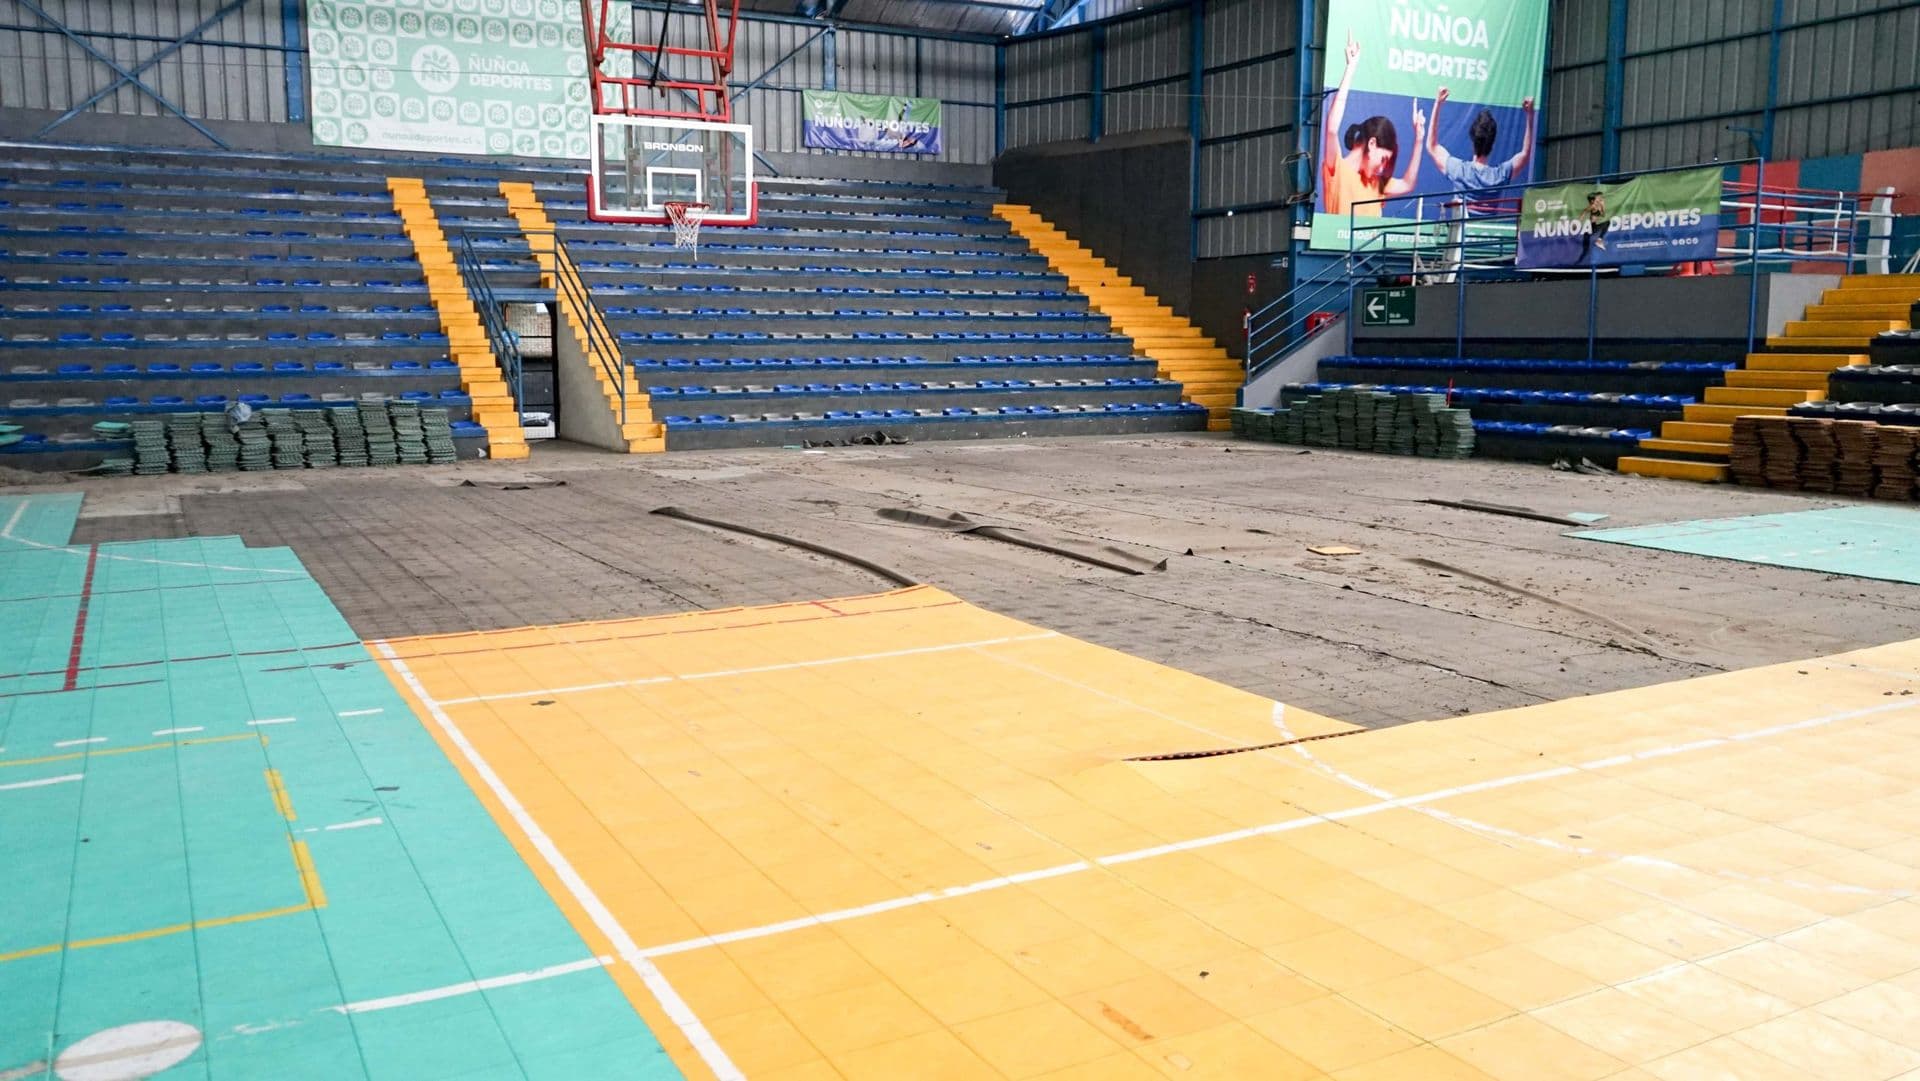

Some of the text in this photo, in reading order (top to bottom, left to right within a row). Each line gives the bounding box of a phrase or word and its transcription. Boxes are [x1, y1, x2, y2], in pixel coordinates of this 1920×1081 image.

[1390, 0, 1489, 49] ÑUÑOA
[468, 52, 530, 75] ÑUÑOA
[1388, 47, 1489, 81] DEPORTES
[469, 73, 553, 92] DEPORTES
[814, 112, 860, 129] ÑUÑOA
[643, 141, 704, 153] BRONSON
[1534, 207, 1701, 239] ÑUÑOA DEPORTES
